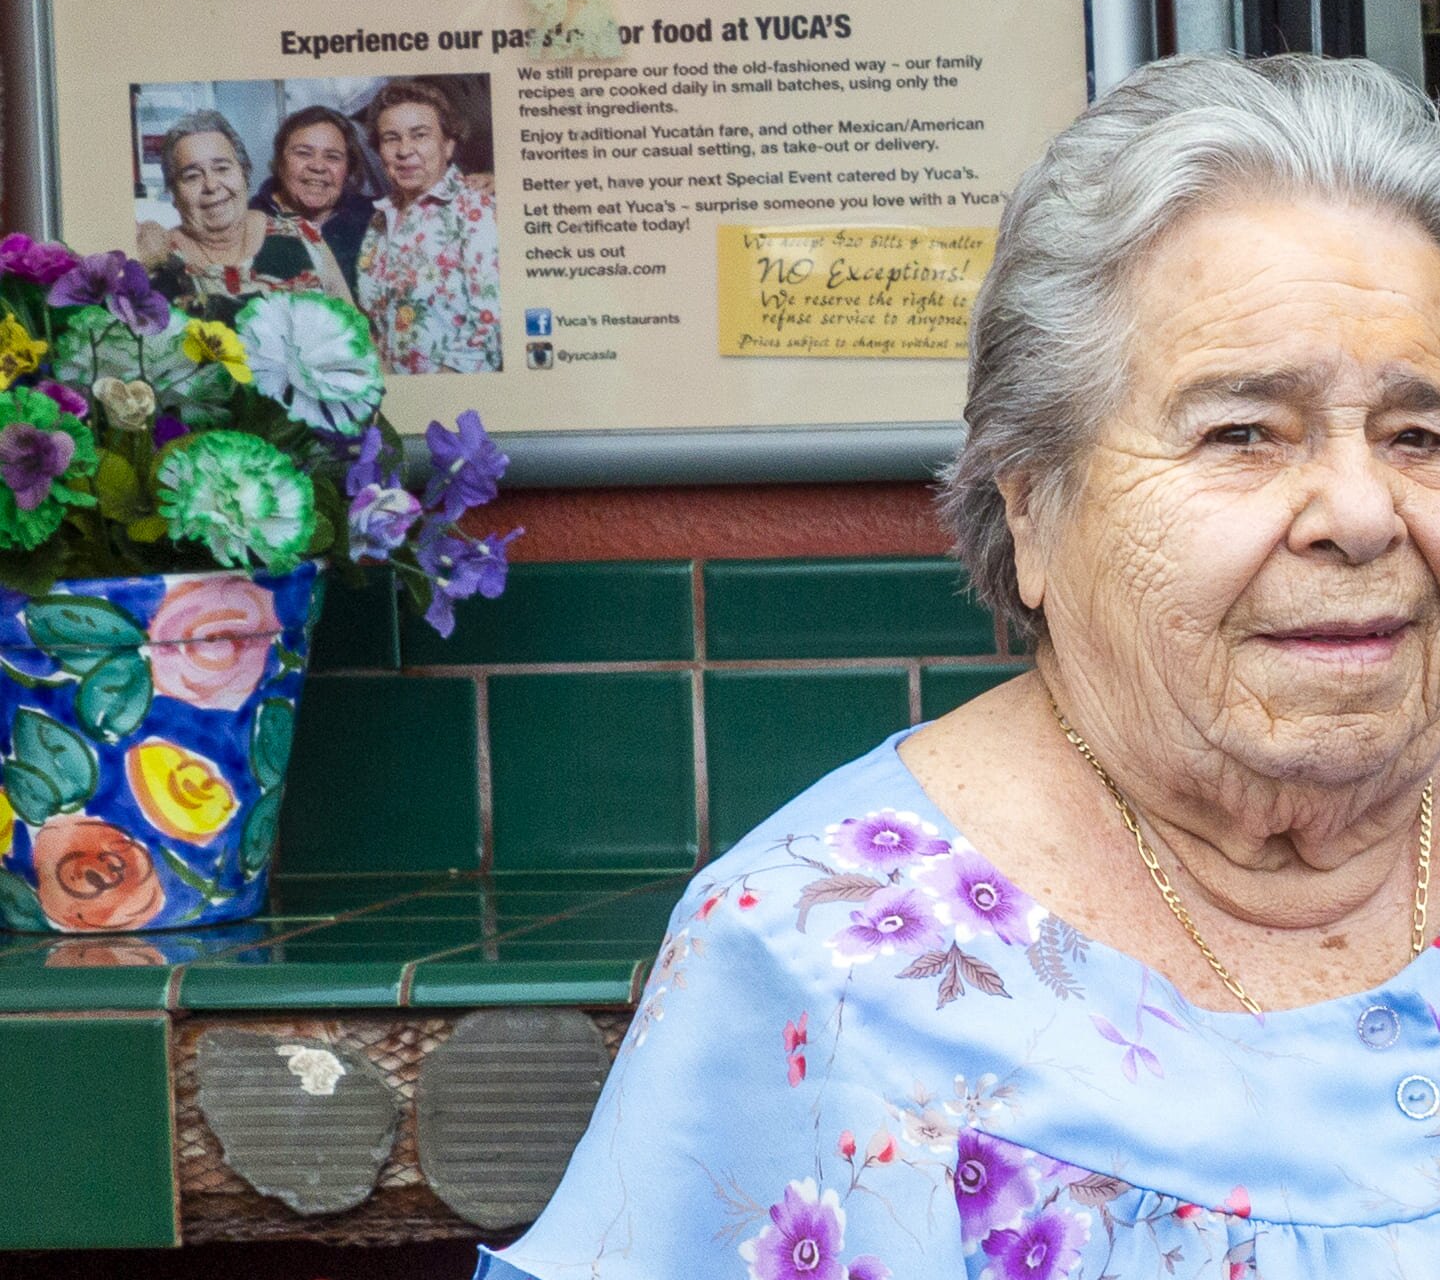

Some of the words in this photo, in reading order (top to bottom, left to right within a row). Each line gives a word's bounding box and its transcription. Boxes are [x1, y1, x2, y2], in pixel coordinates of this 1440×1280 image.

[281, 28, 429, 59] Experience
[438, 29, 482, 50] our
[652, 19, 712, 43] food
[722, 18, 748, 42] at
[755, 14, 851, 40] YUCA'S
[519, 101, 582, 117] freshest
[586, 100, 679, 117] ingredients.
[726, 170, 783, 190] Special
[788, 170, 832, 185] Event
[837, 168, 897, 184] catered
[901, 168, 919, 185] by
[924, 165, 979, 181] Yuca's.
[525, 245, 572, 261] check
[576, 246, 595, 259] us
[600, 244, 625, 259] out
[525, 261, 667, 278] www.yucasla.com
[757, 257, 815, 286] NO
[827, 259, 970, 290] Exceptions!
[556, 315, 598, 328] Yuca's
[602, 312, 680, 326] Restaurants
